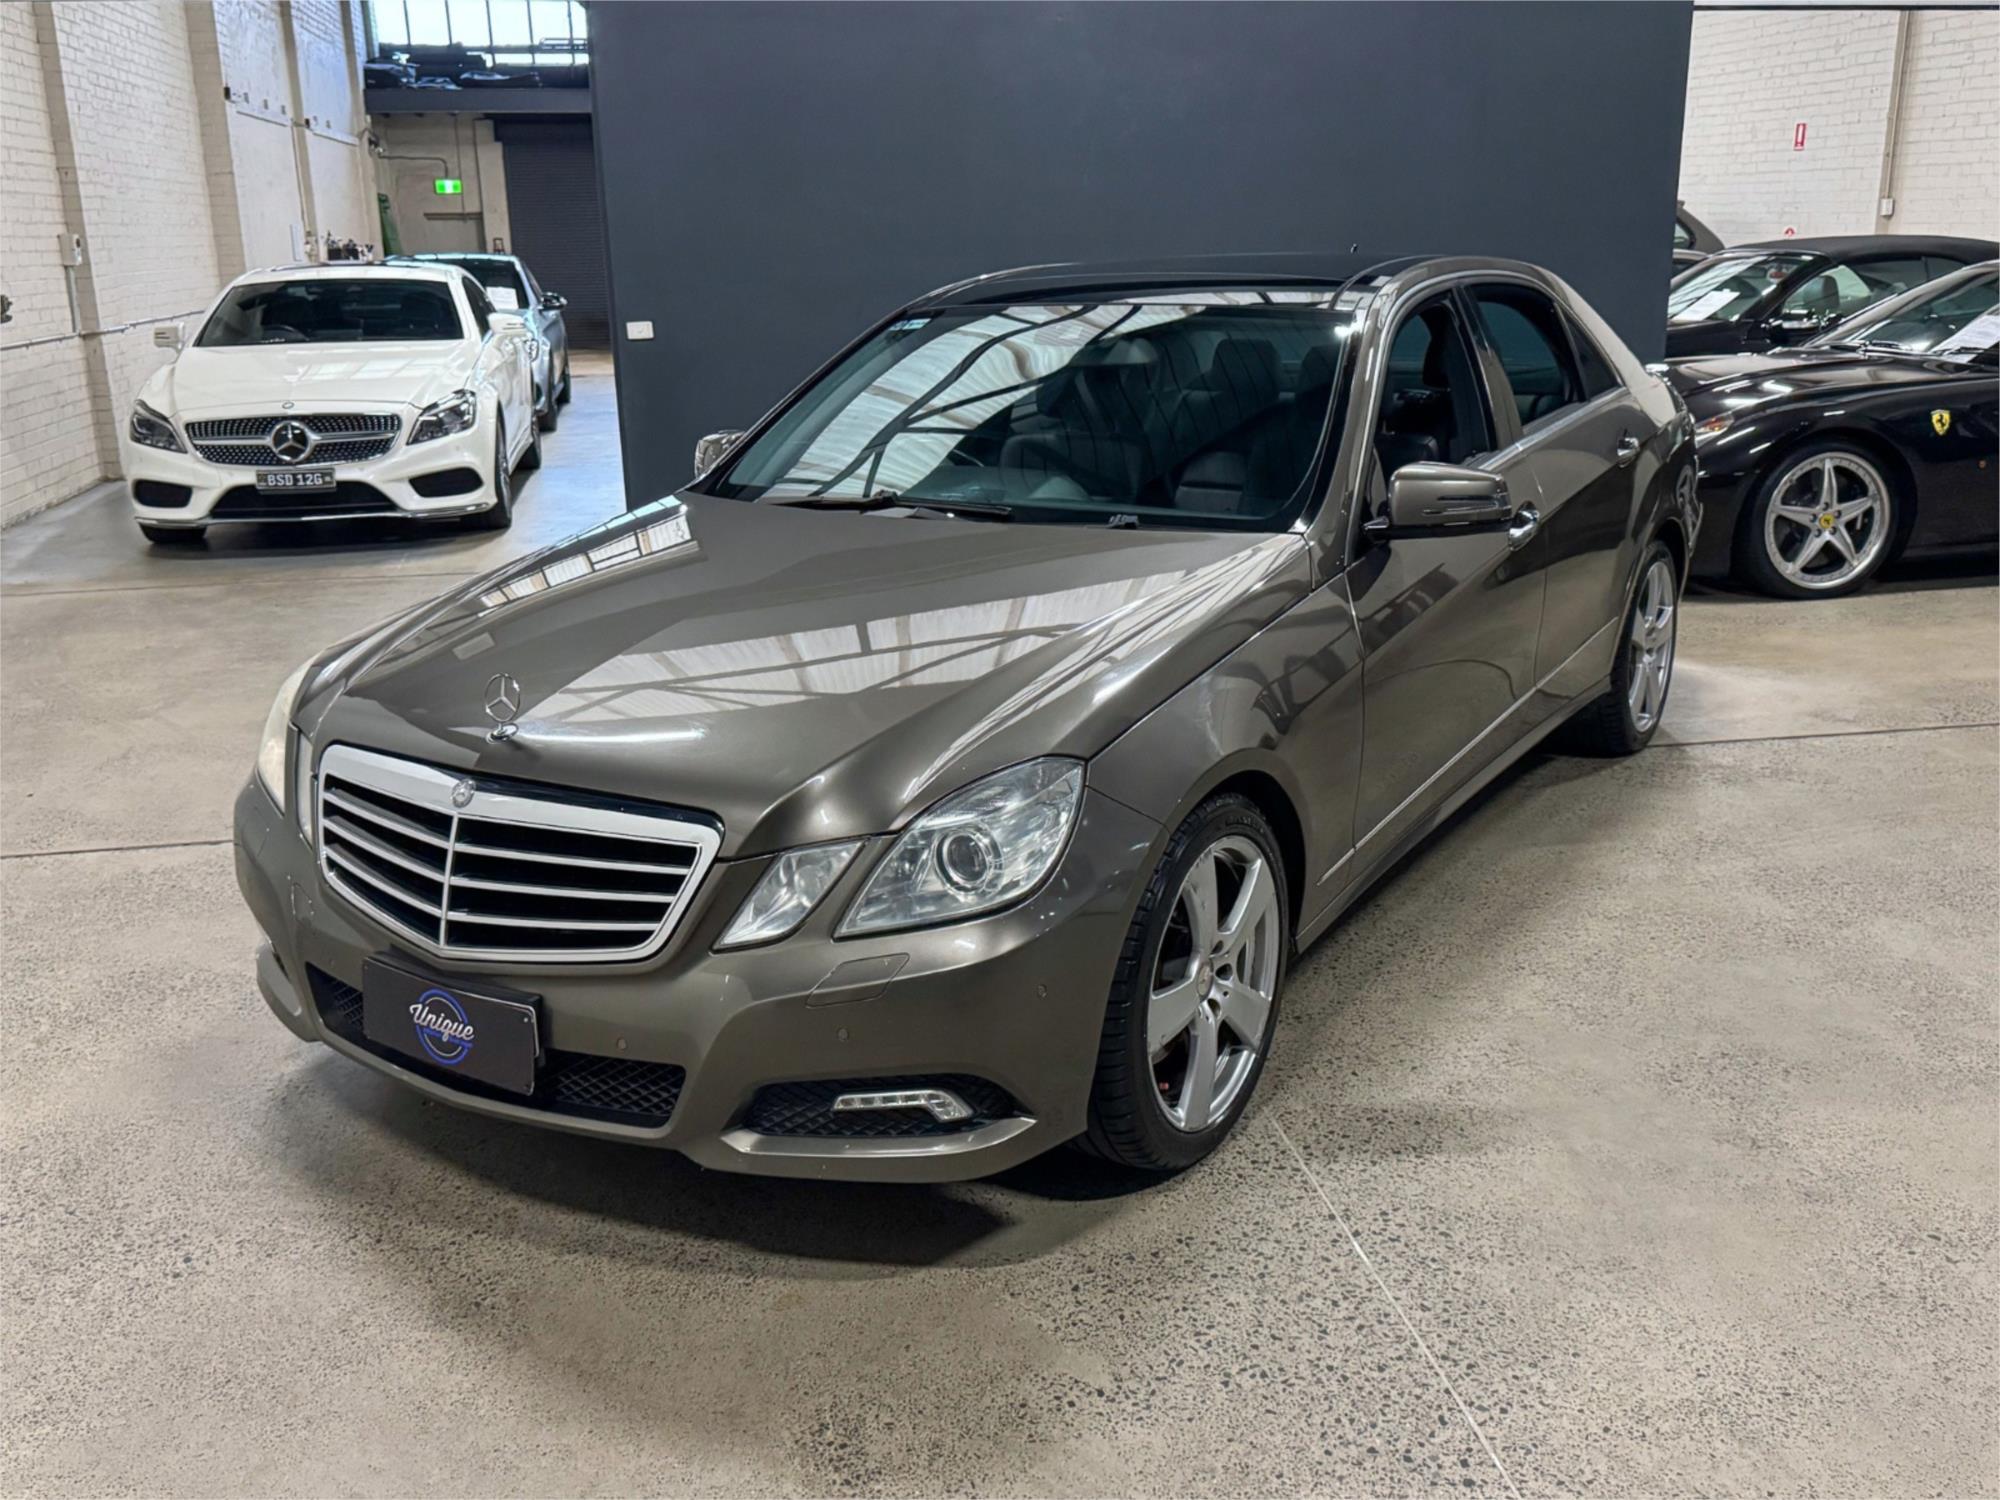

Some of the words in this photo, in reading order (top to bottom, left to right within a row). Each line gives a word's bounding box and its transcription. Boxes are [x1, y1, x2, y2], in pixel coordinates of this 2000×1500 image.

[267, 474, 293, 486] BSD
[296, 473, 323, 486] 12G
[409, 1003, 475, 1042] Unique
